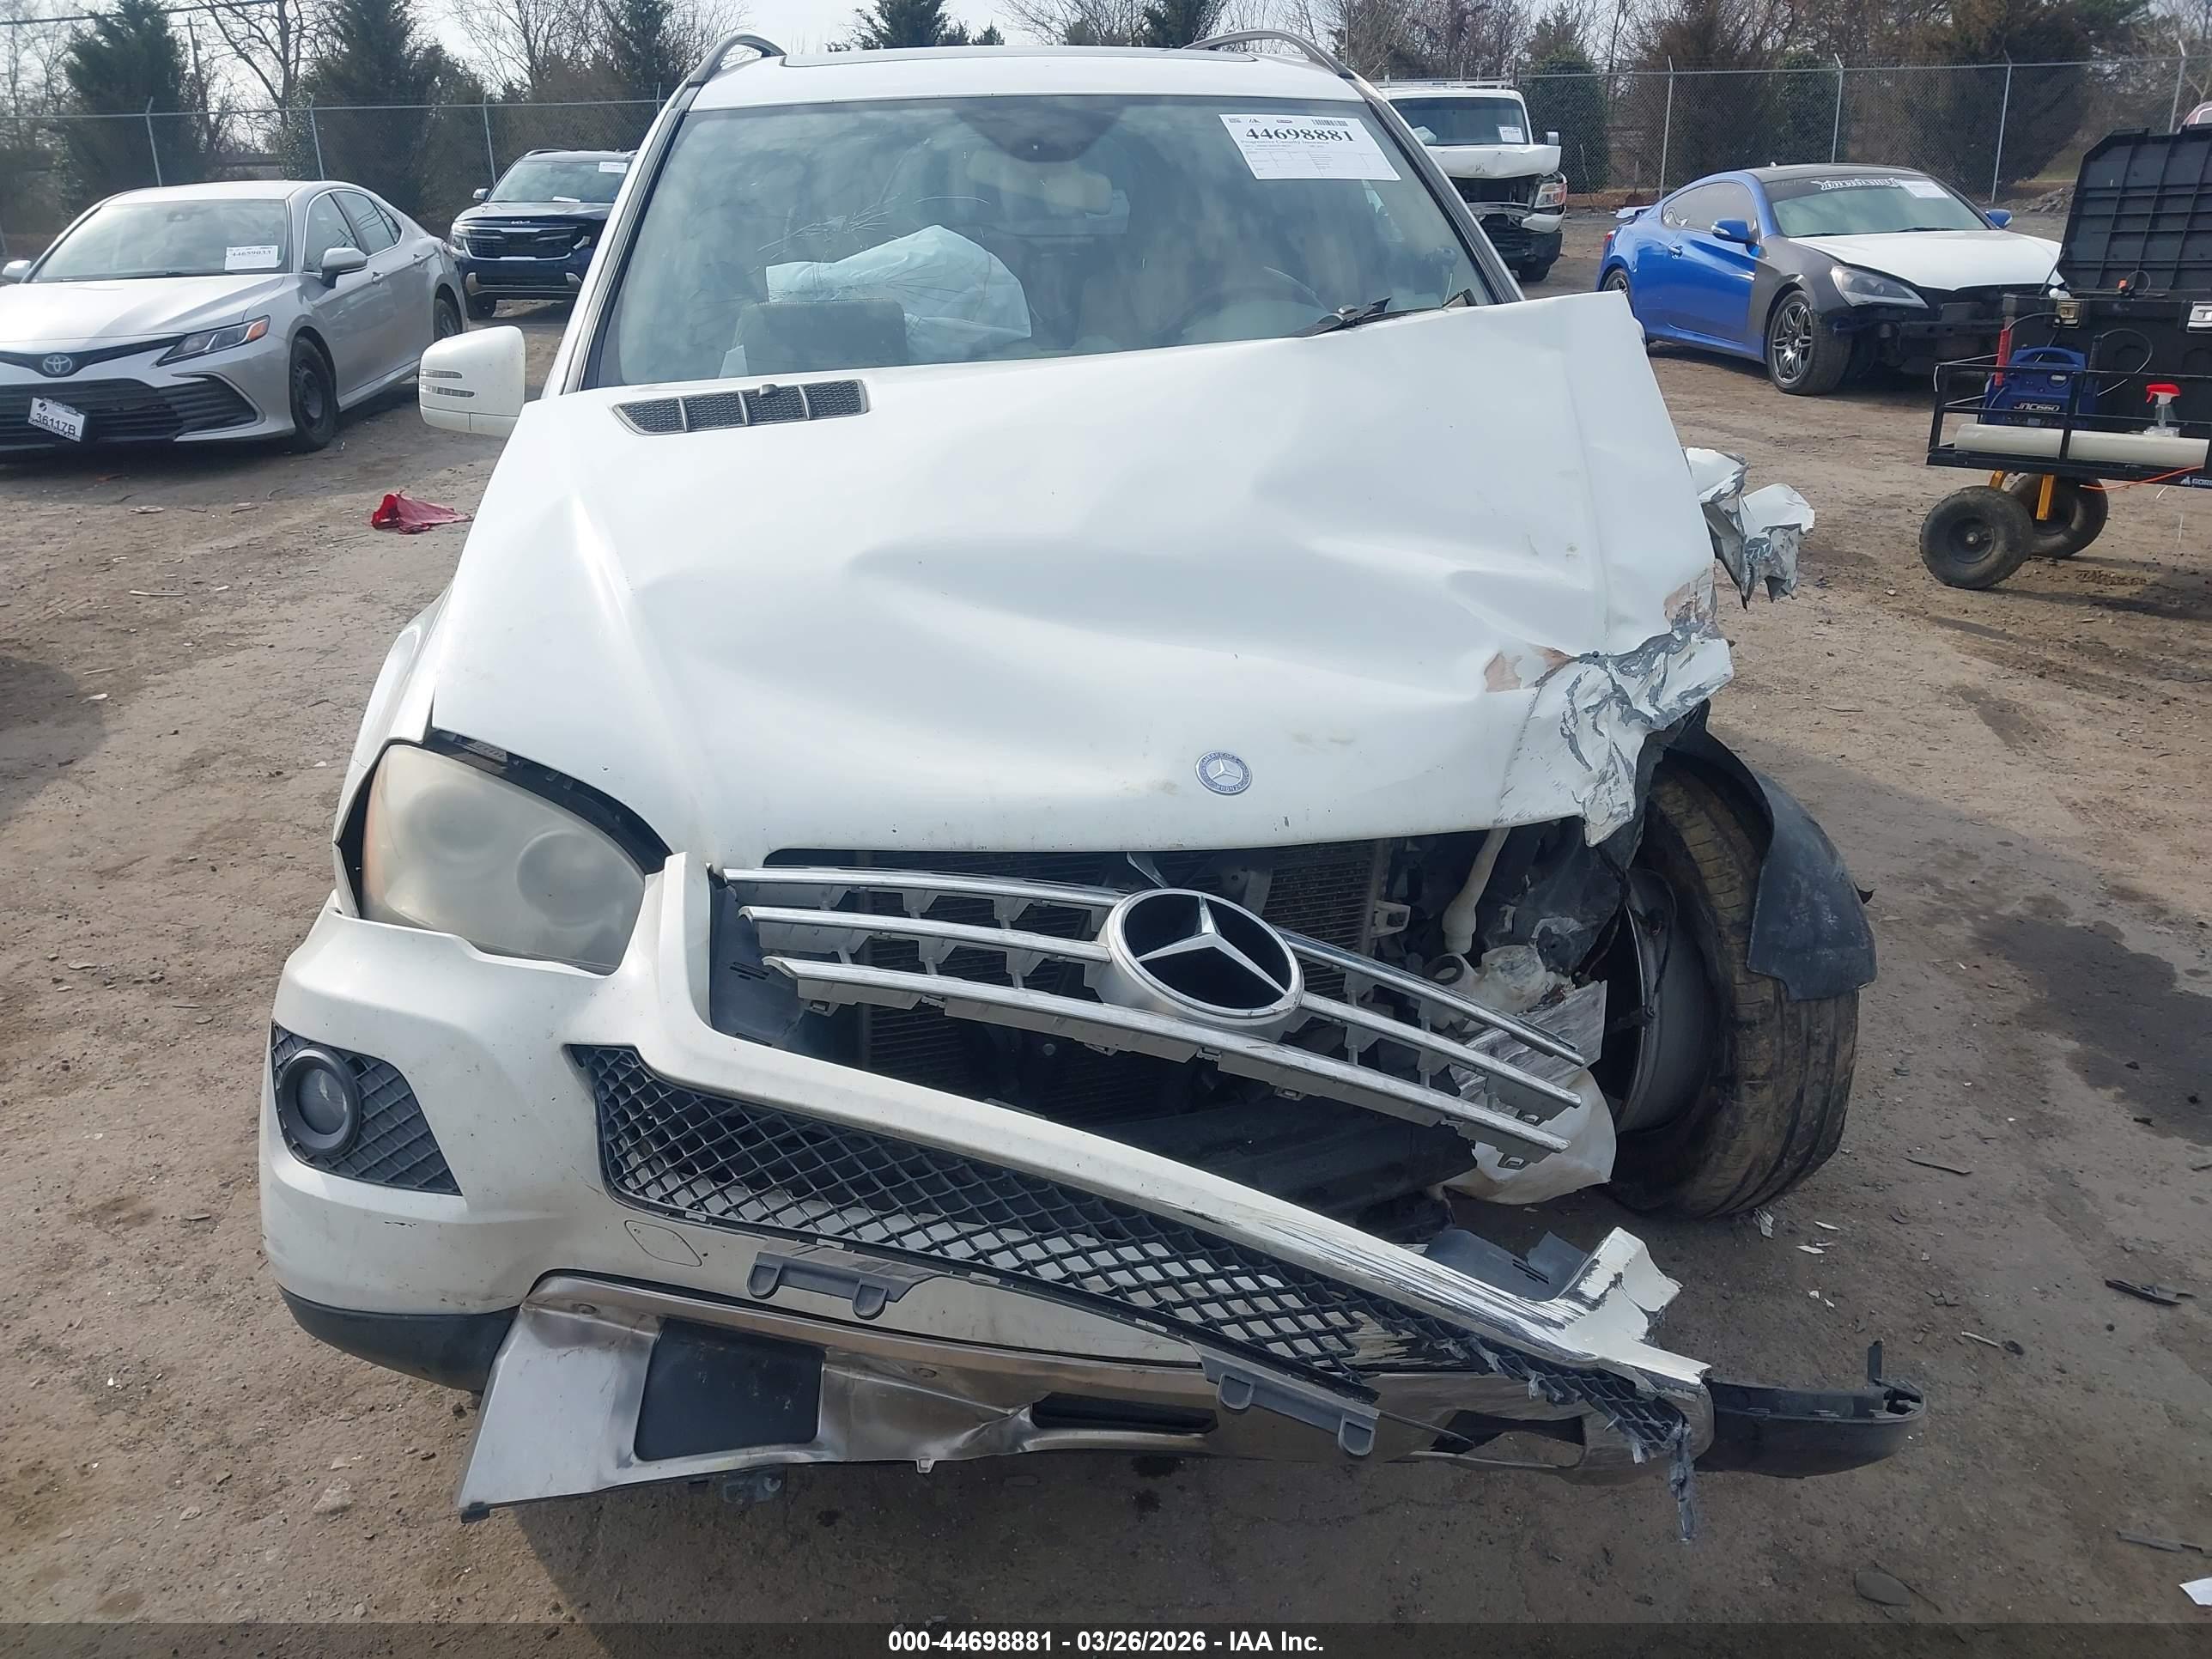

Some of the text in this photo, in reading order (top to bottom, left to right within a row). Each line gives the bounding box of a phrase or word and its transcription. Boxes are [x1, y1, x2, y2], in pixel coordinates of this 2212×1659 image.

[1246, 128, 1355, 142] 44698881
[2014, 403, 2060, 412] JNC660
[36, 413, 76, 435] 36117B
